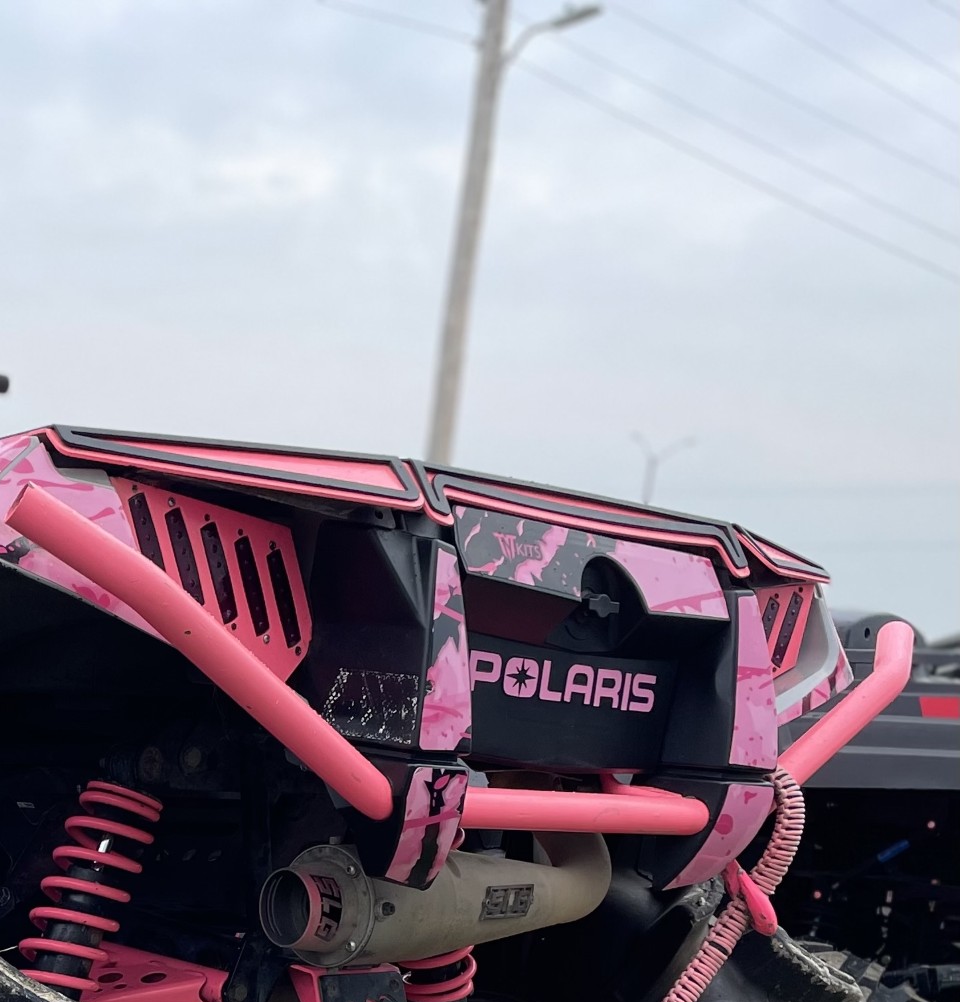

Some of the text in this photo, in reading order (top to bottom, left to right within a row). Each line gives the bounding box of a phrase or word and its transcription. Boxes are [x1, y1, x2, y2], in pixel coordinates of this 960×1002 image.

[516, 543, 541, 559] KITS
[469, 650, 657, 713] POLARIS
[313, 874, 342, 942] SLG
